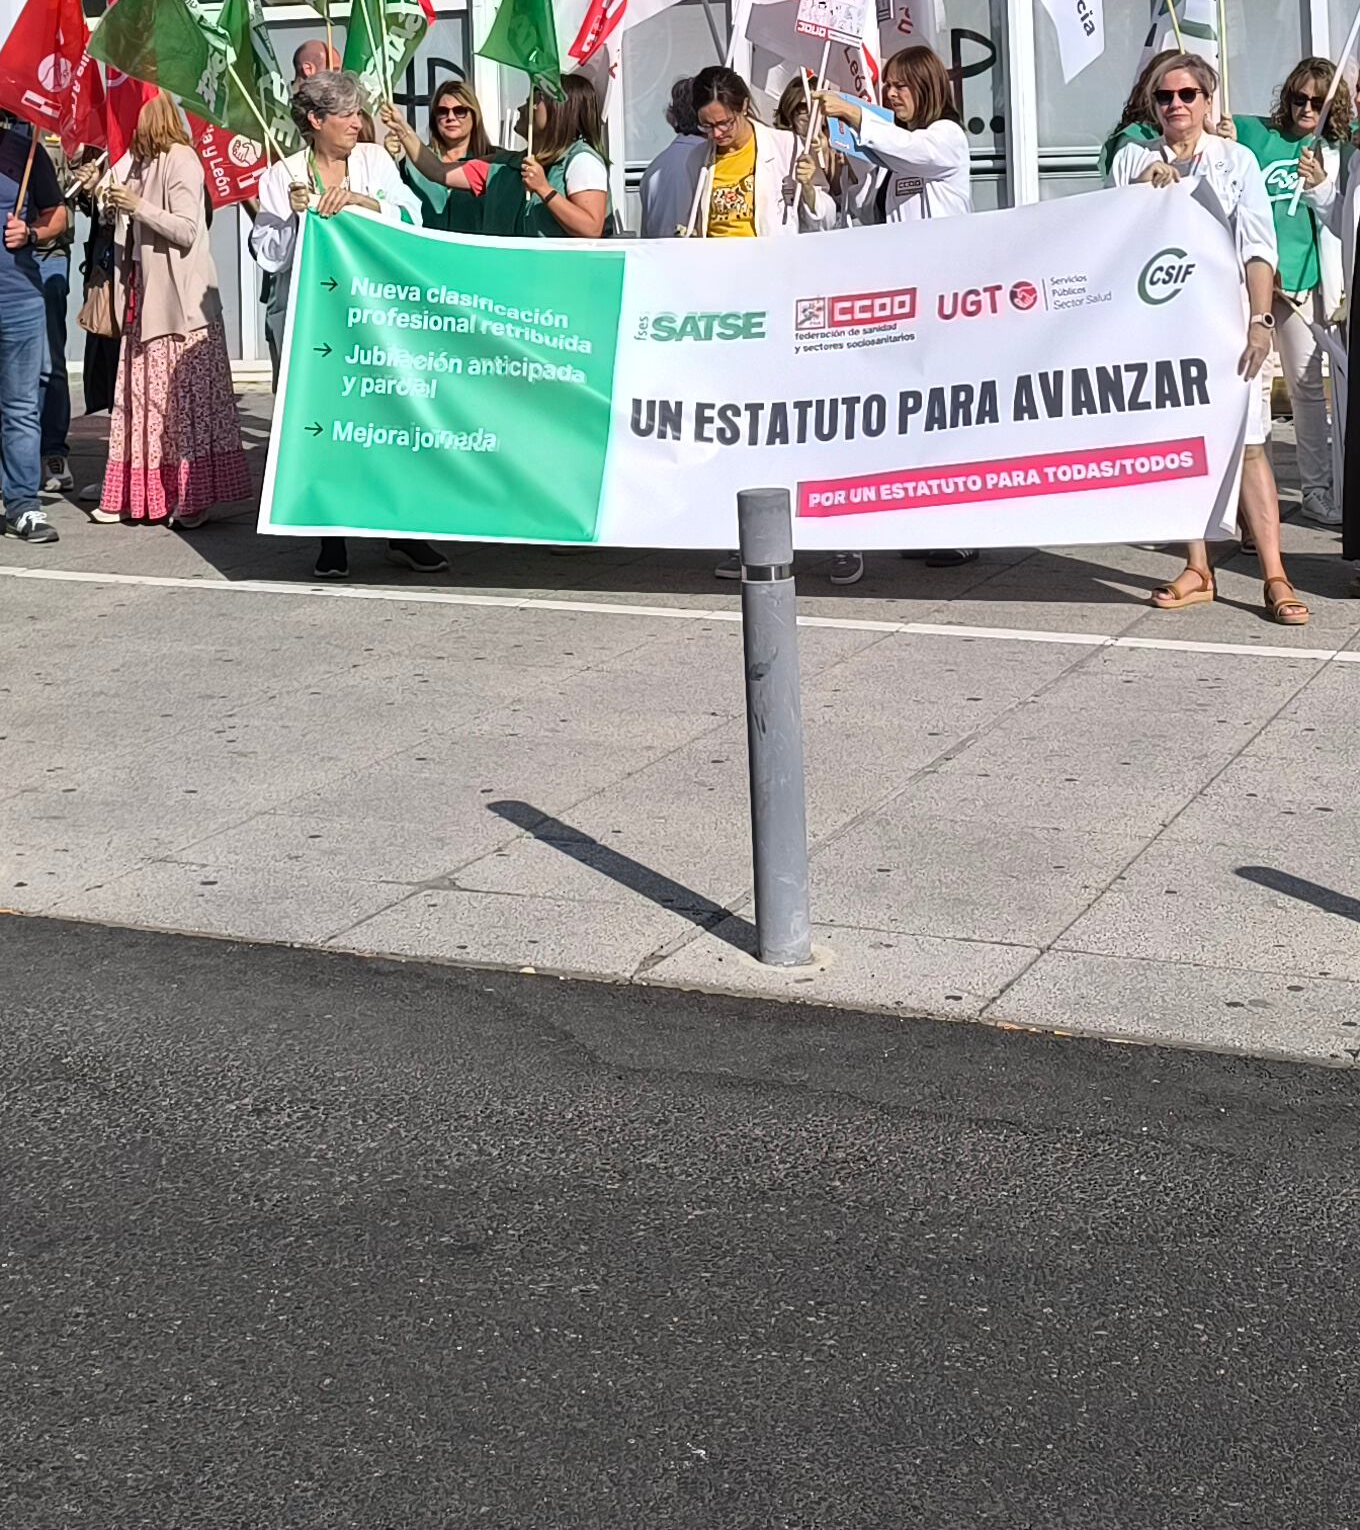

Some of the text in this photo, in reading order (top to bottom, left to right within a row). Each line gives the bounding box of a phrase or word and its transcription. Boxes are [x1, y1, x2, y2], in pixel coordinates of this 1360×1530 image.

[210, 157, 231, 198] León
[1050, 275, 1087, 286] Servicios
[1149, 263, 1196, 286] CSIF
[351, 277, 569, 328] Nueva clasificación
[833, 293, 912, 321] CCOO
[937, 285, 1003, 320] UGT
[1052, 287, 1086, 297] Públicos
[1053, 291, 1112, 310] Sector Salud
[347, 306, 592, 354] profesional retribuida
[650, 311, 766, 342] SATSE
[795, 322, 897, 340] federación de sanidad
[795, 331, 916, 355] y sectores sociosanitarios
[345, 344, 587, 384] Jubilación anticipada
[341, 376, 437, 399] y parcial
[630, 357, 1211, 447] UN ESTATUTO PARA AVANZAR
[333, 420, 498, 453] Mejora jornada
[808, 450, 1194, 509] POR UN ESTATUTO PARA TODAS/TODOS
